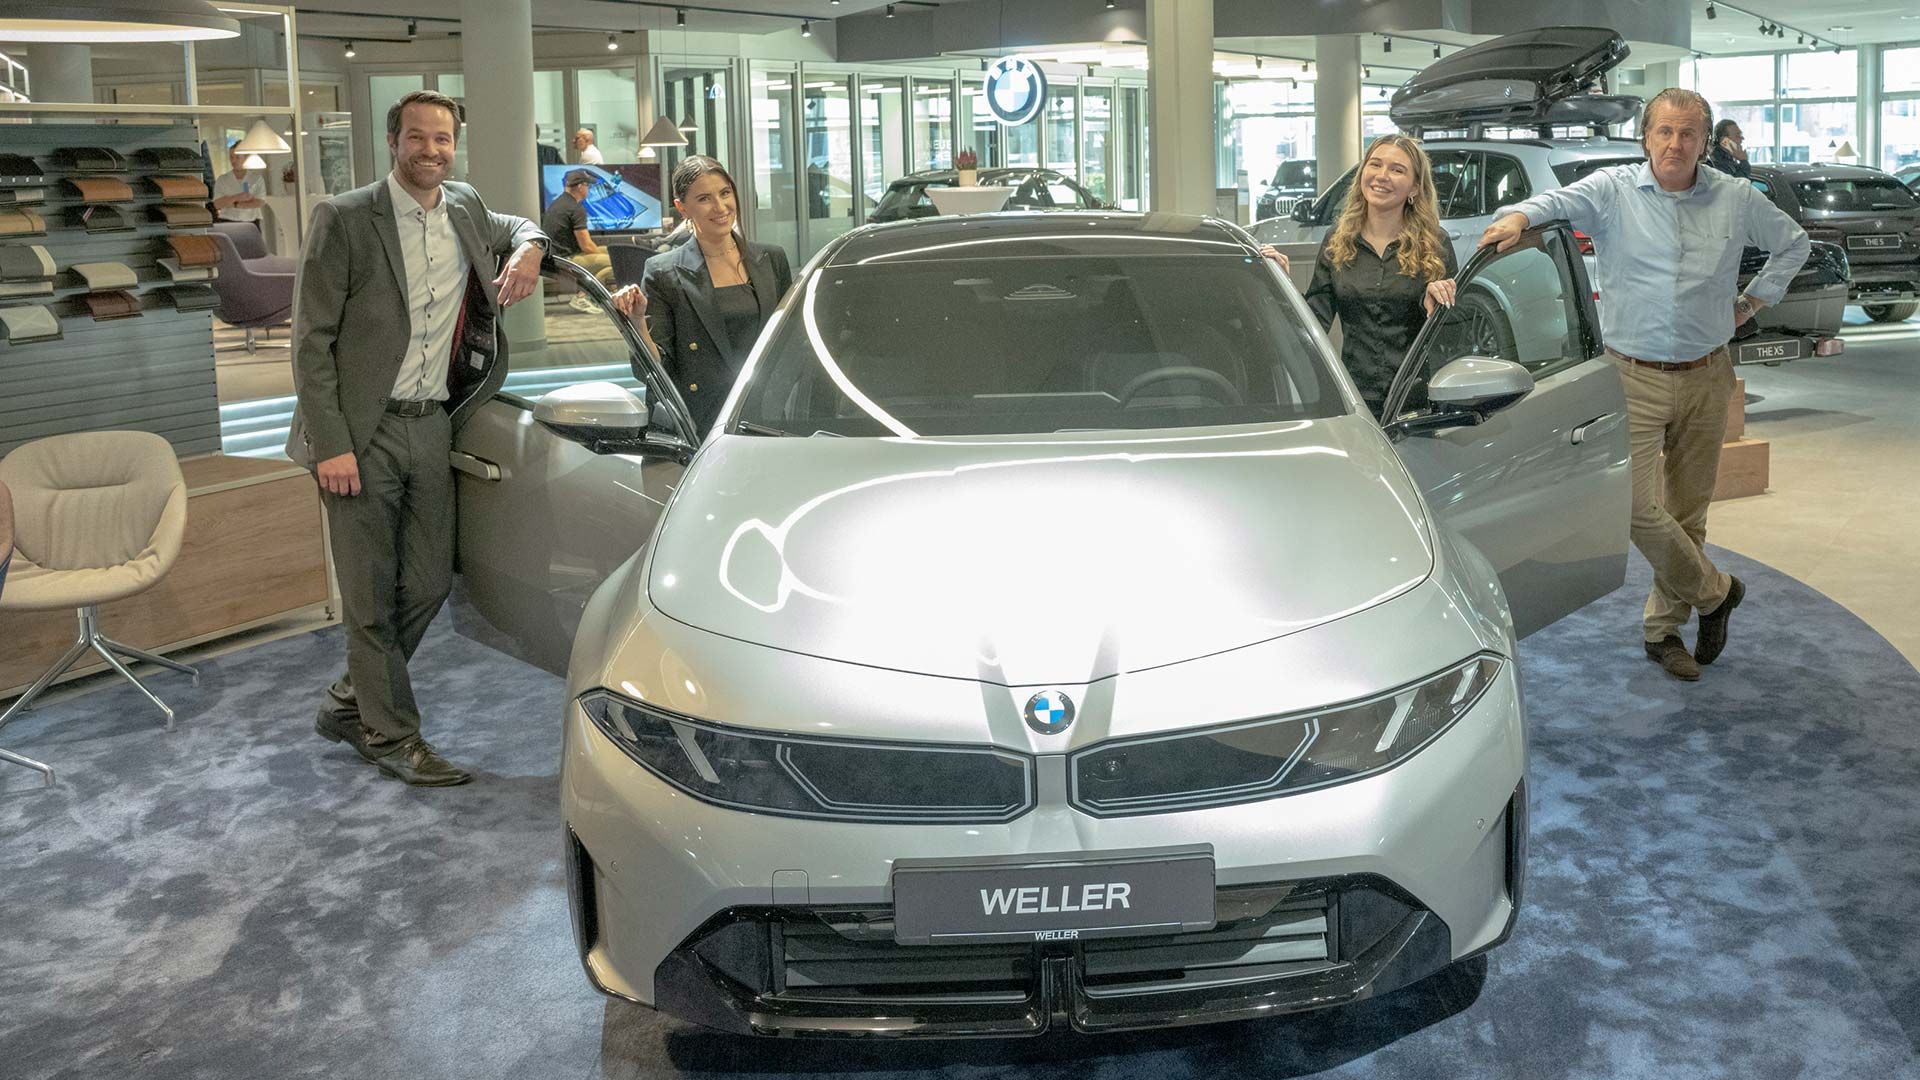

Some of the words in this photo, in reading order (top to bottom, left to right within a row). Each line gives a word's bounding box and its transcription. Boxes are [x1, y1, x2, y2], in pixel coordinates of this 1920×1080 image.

[1864, 238, 1878, 246] THE
[1757, 346, 1773, 357] THE
[1774, 345, 1784, 356] X5
[980, 882, 1131, 915] WELLER
[1034, 930, 1079, 941] WELLER
